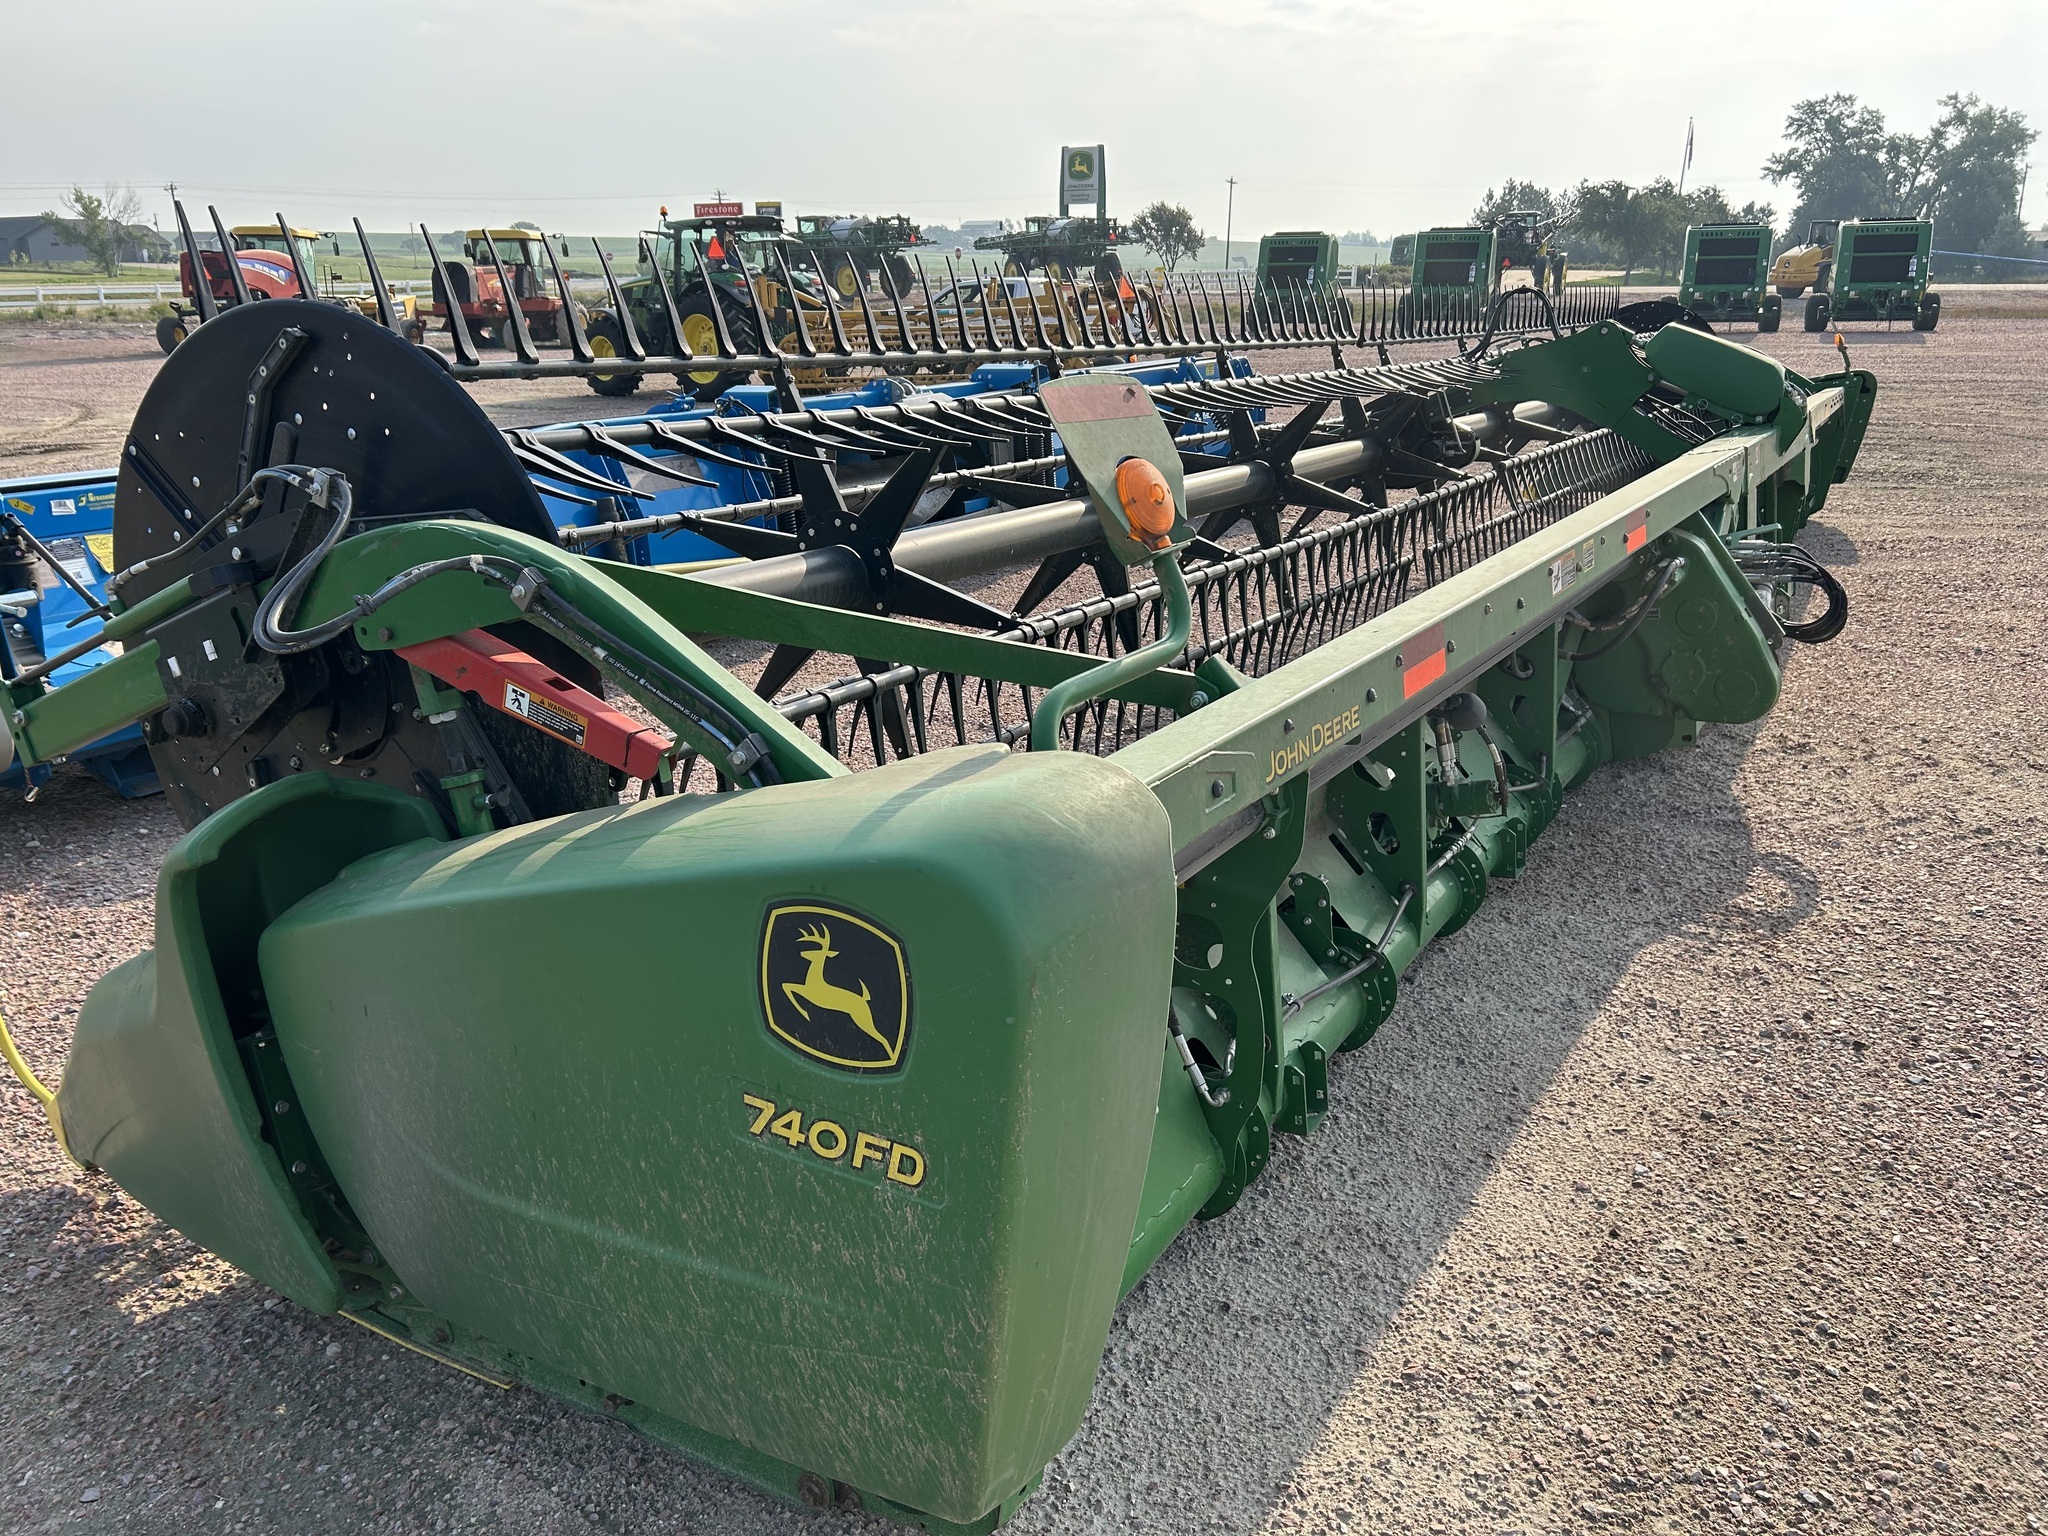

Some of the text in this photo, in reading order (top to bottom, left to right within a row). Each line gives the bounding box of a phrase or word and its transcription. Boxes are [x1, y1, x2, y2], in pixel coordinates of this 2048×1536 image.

[695, 206, 739, 215] Firestone
[643, 682, 657, 693] Flame
[655, 689, 674, 706] Resistant
[547, 701, 579, 721] WARNING
[1265, 704, 1361, 783] JOHN DEERE
